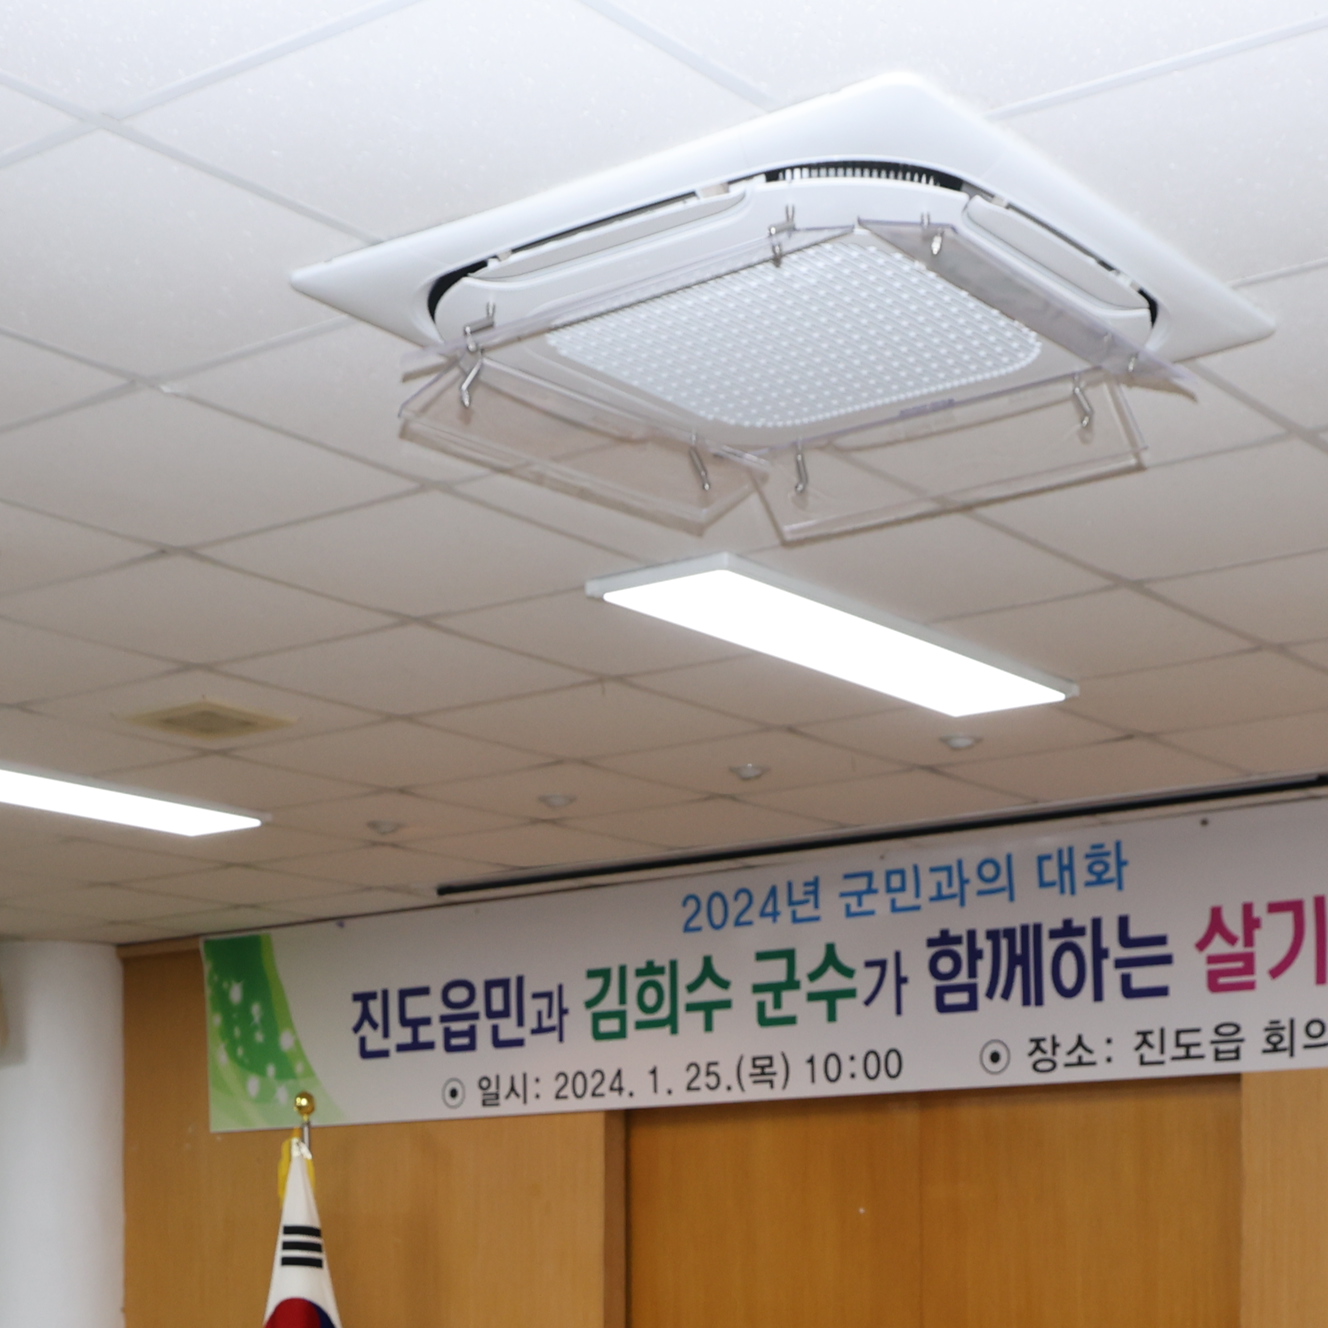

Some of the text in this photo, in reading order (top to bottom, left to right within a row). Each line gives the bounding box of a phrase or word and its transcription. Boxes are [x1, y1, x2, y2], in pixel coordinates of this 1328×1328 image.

[681, 840, 1129, 933] 2024년 군민과의 대화
[351, 974, 569, 1060] 진도읍민과
[584, 955, 732, 1041] 김희수
[752, 942, 908, 1027] 군수가
[926, 915, 1173, 1014] 함께하는
[478, 1072, 540, 1108] 일시:
[554, 1068, 634, 1100] 2024.
[649, 1065, 672, 1096] 1.
[806, 1048, 903, 1085] 10:00
[1027, 1033, 1114, 1074] 장소:
[1134, 1021, 1245, 1067] 진도읍
